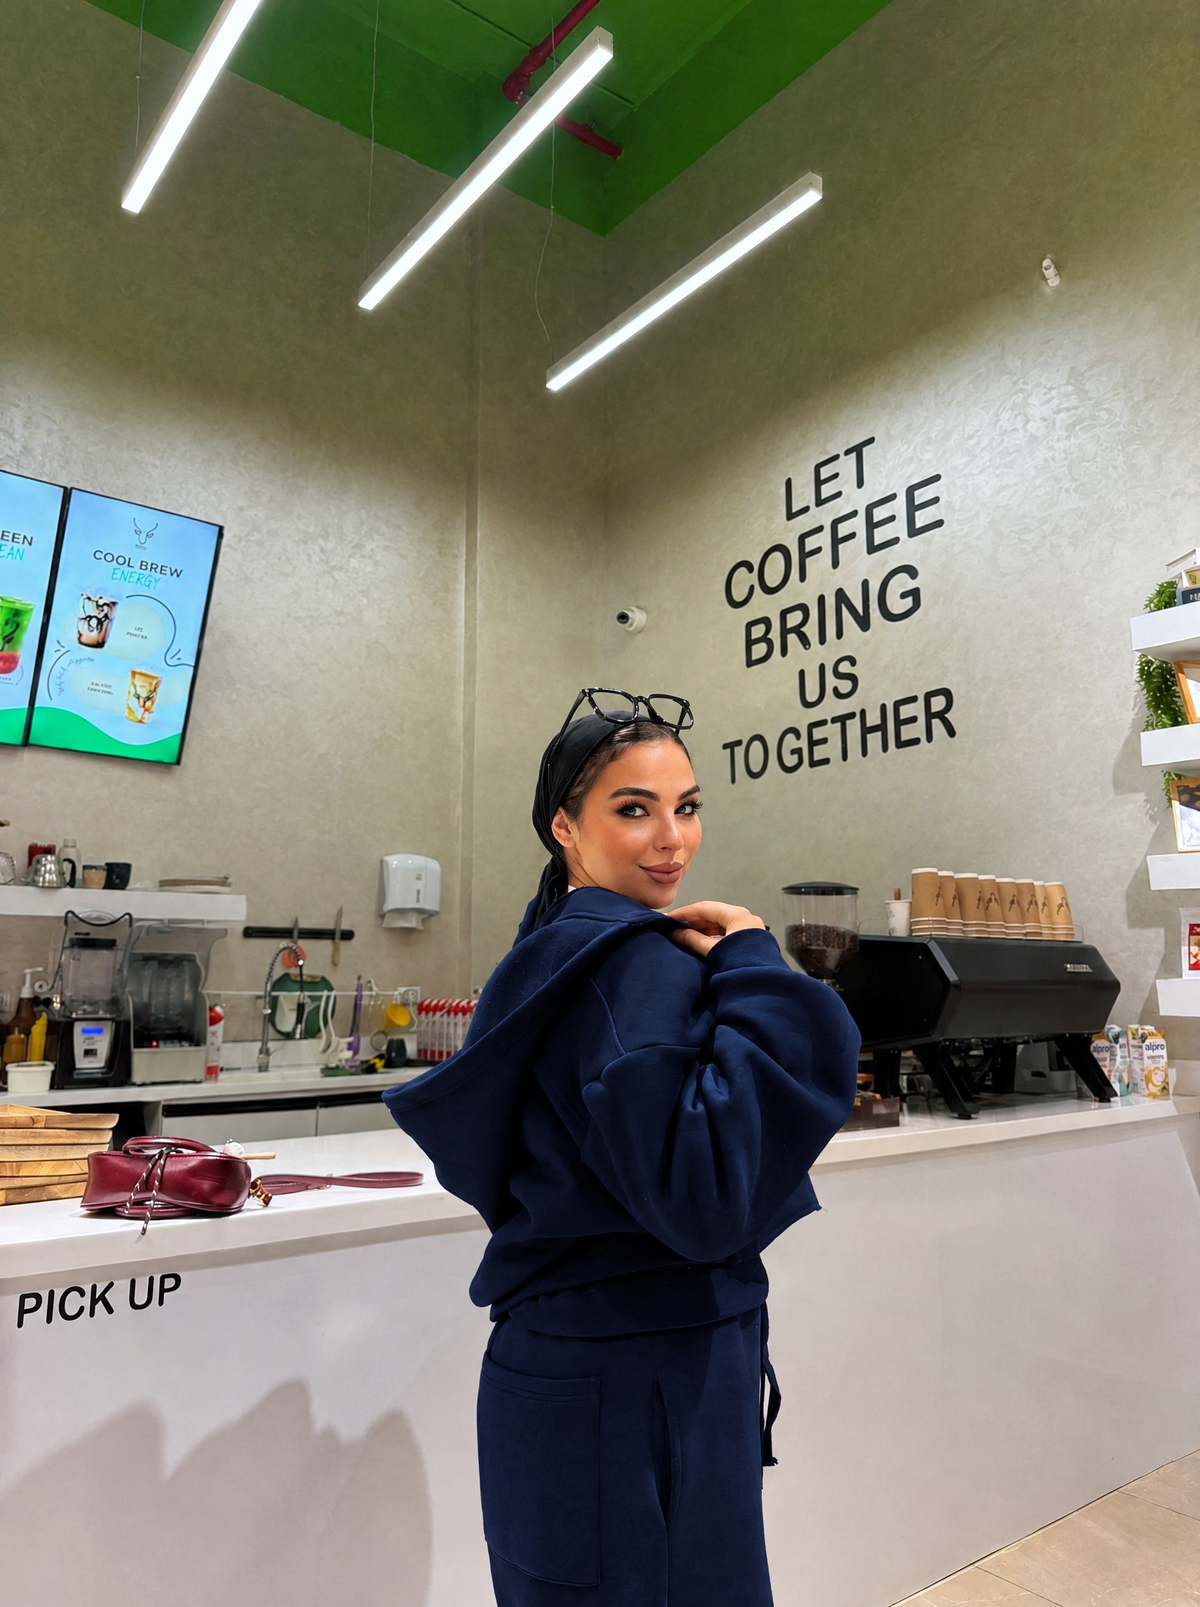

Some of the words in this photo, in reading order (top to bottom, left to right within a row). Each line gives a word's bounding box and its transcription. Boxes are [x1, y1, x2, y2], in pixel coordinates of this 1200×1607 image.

[784, 436, 876, 522] LET
[93, 549, 135, 569] COOL
[139, 559, 184, 578] BREW
[724, 473, 945, 610] COFFEE
[111, 567, 162, 590] ENERGY
[744, 564, 921, 669] BRING
[798, 655, 859, 710] US
[721, 687, 957, 785] TOGETHER
[1091, 1043, 1110, 1055] alpro
[1144, 1042, 1165, 1053] alpro
[16, 1280, 115, 1329] PICK
[128, 1272, 182, 1311] UP
